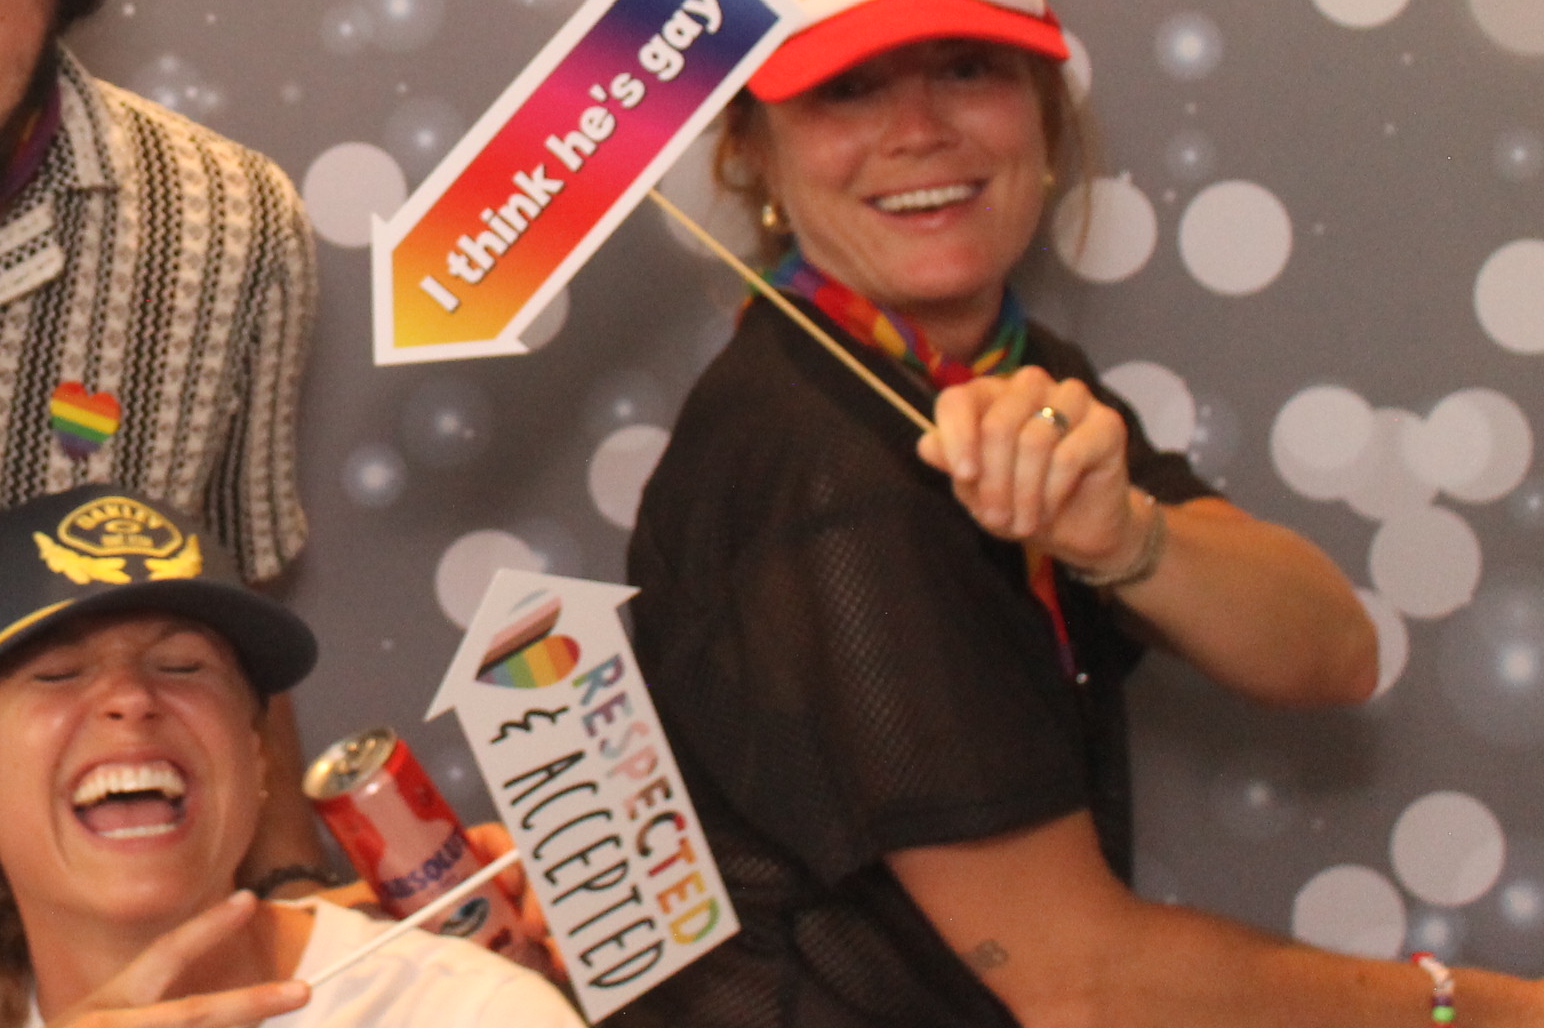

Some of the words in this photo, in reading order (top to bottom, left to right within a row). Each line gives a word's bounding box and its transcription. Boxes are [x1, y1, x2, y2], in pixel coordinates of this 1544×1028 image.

[418, 274, 460, 313] I
[446, 163, 566, 285] think
[544, 71, 646, 173] he's
[381, 826, 469, 899] SOLU
[503, 750, 666, 991] ACCEPTED
[572, 654, 722, 946] RESPECTED
